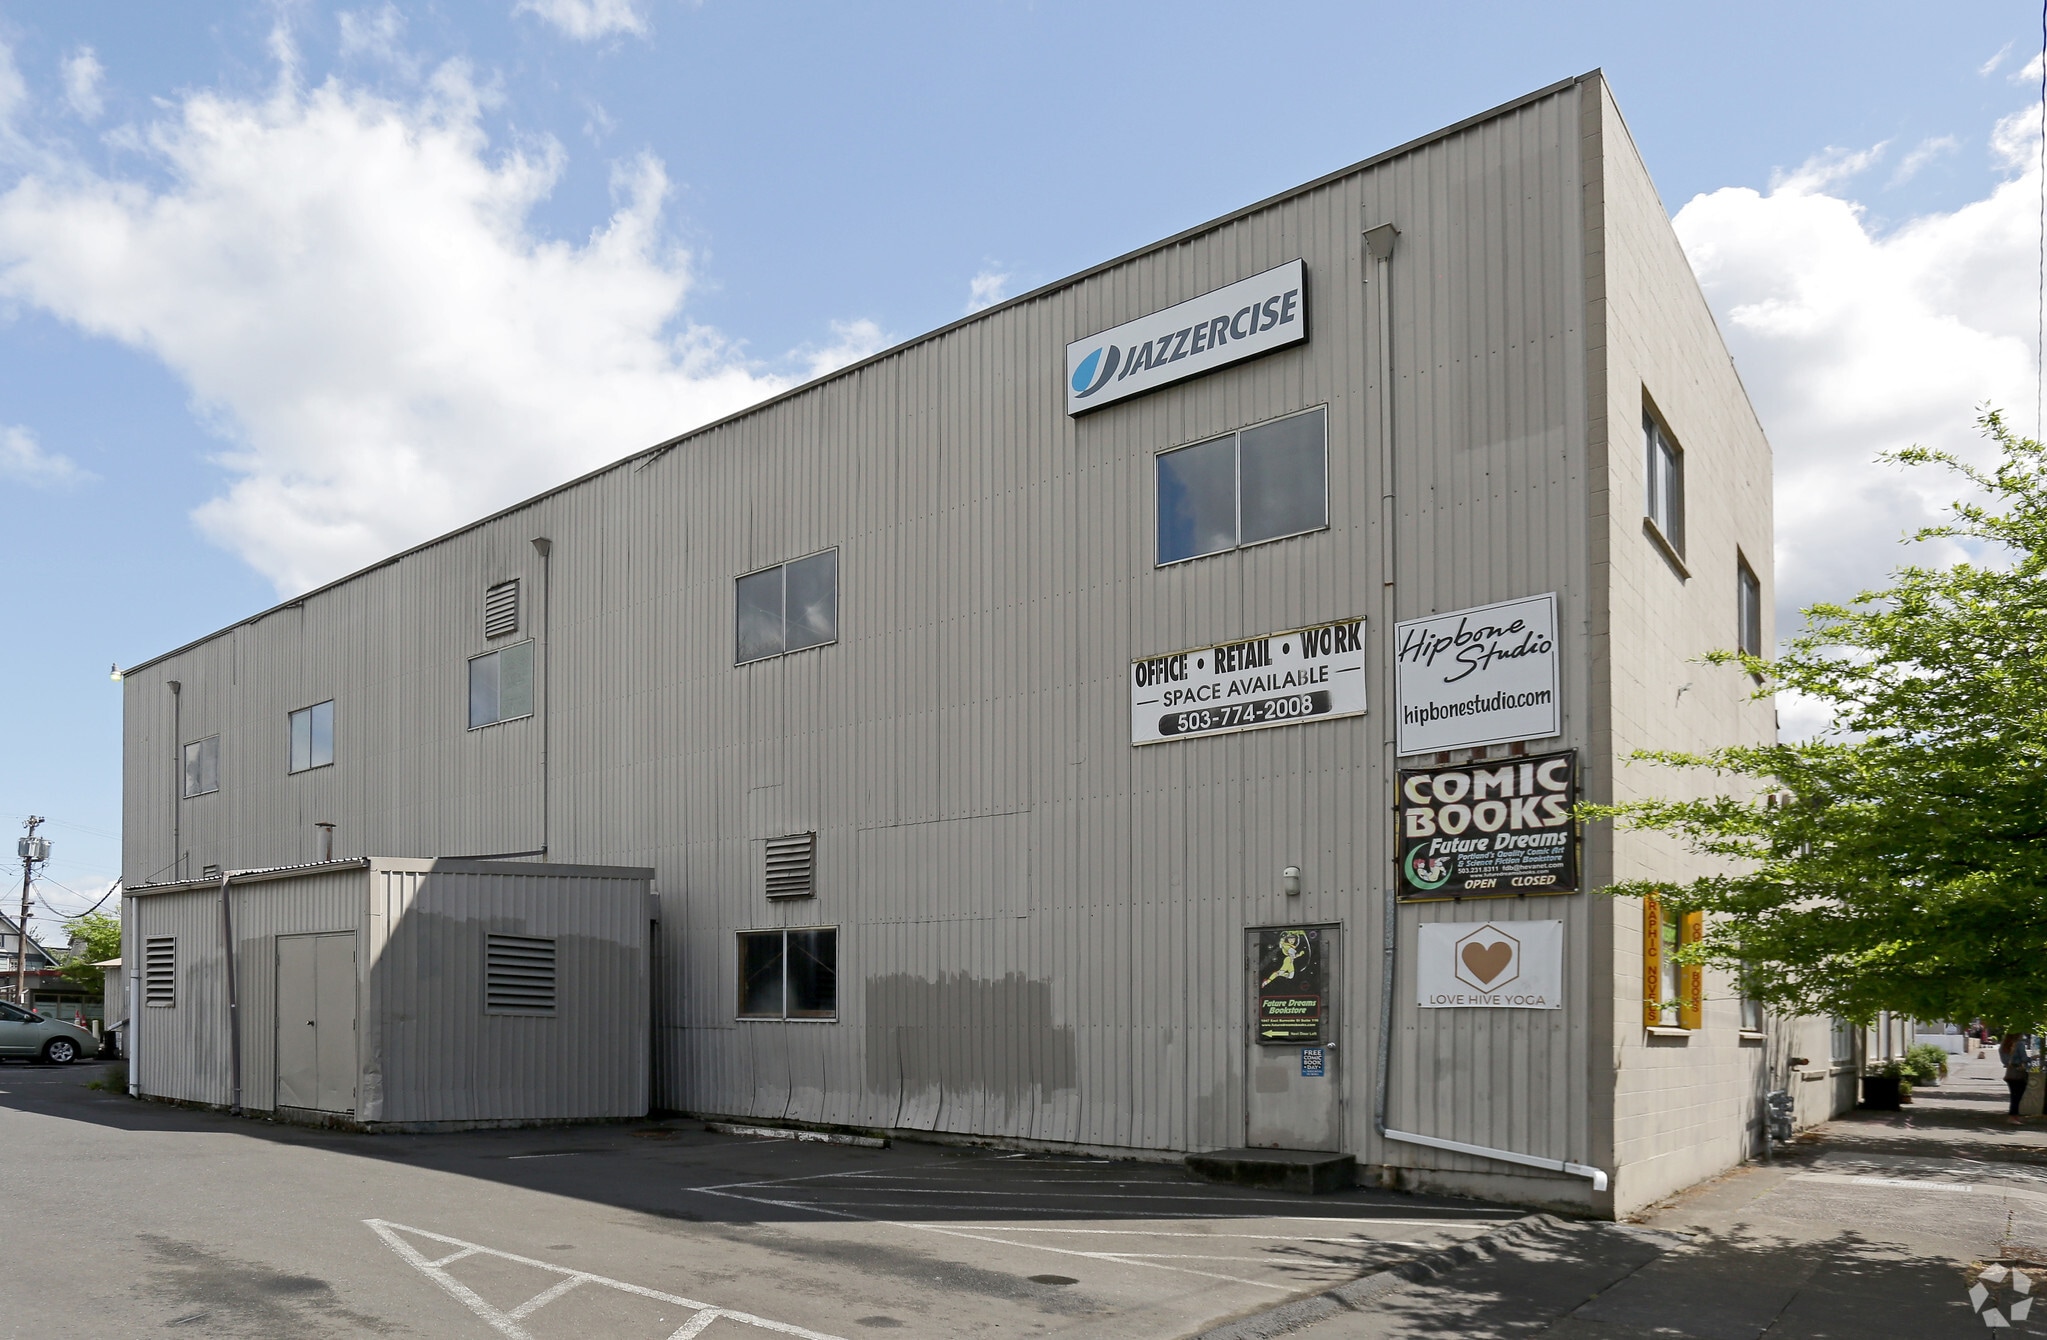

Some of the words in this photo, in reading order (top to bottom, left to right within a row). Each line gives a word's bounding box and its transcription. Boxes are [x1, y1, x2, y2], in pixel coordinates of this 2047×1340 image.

[1117, 288, 1299, 382] JAZZERCISE
[1135, 654, 1188, 688] OFFICE
[1214, 638, 1273, 675] RETAIL
[1300, 621, 1362, 660] WORK
[1398, 617, 1526, 667] Hipbone
[1443, 630, 1552, 683] Studio
[1163, 682, 1221, 708] SPACE
[1226, 665, 1329, 698] AVAILABLE
[1177, 695, 1313, 732] 503-774-2008
[1404, 689, 1551, 727] hipbonestudio.com
[1403, 758, 1569, 805] COMIC
[1404, 793, 1569, 838] BOOKS
[1428, 837, 1490, 857] Future
[1493, 831, 1568, 850] Dreams
[1457, 851, 1495, 861] Portland's
[1496, 849, 1526, 858] Quality
[1526, 848, 1550, 856] Comic
[1551, 846, 1566, 854] Art
[1457, 860, 1465, 868] &
[1466, 859, 1493, 867] Science
[1494, 857, 1521, 866] Fiction
[1522, 855, 1563, 864] Bookstore
[1464, 878, 1498, 890] OPEN
[1511, 874, 1557, 887] CLOSED
[1647, 900, 1658, 957] RAPHIC
[1262, 999, 1287, 1008] Future
[1288, 999, 1317, 1007] Dreams
[1269, 1006, 1307, 1014] Bookstore
[1430, 994, 1465, 1005] LOVE
[1468, 994, 1501, 1005] HIVE
[1505, 995, 1546, 1005] YOGA
